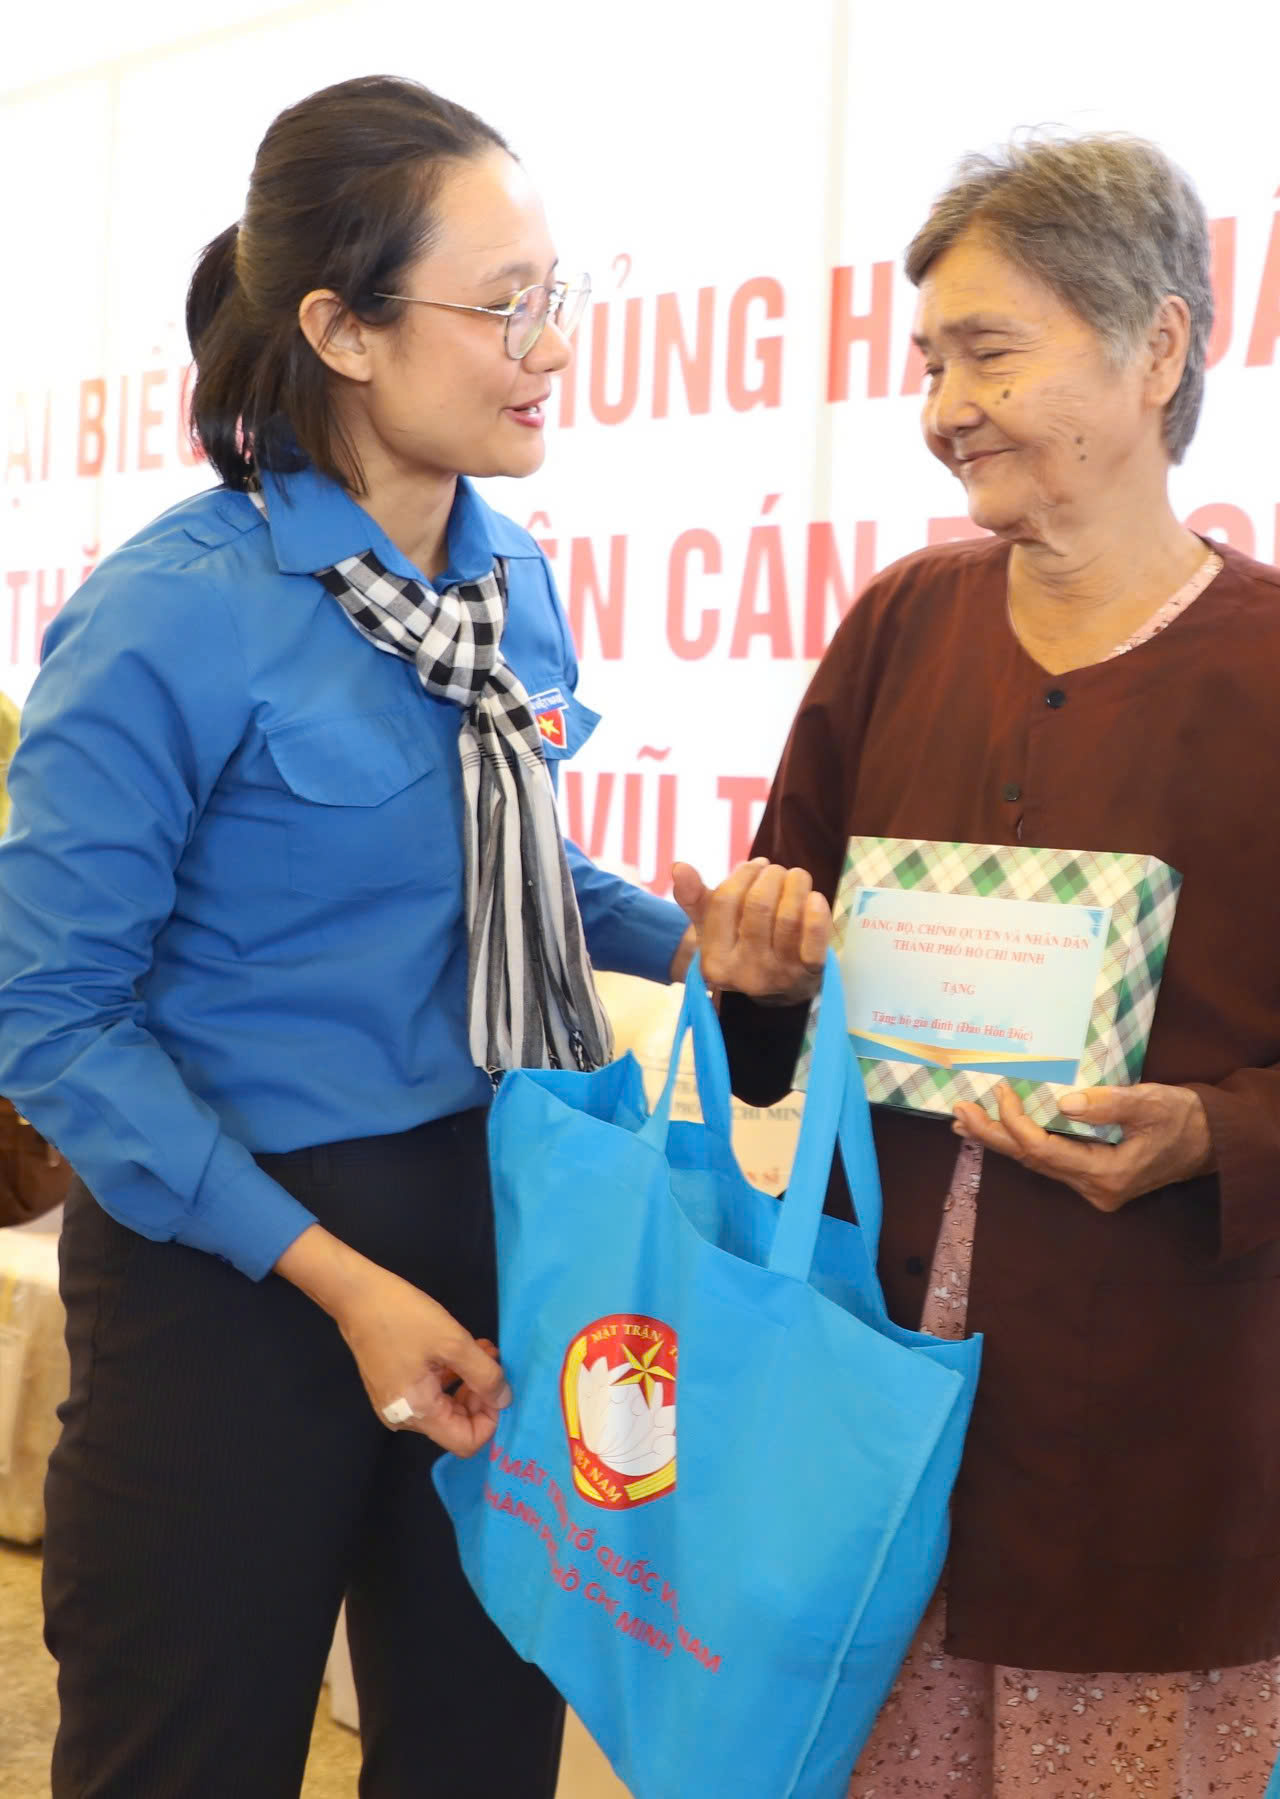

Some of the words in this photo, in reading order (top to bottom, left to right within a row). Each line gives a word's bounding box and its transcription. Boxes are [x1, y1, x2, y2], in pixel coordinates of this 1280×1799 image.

[665, 493, 877, 661] CÁN
[564, 744, 679, 897] VŨ
[596, 1545, 660, 1593] QUỐC
